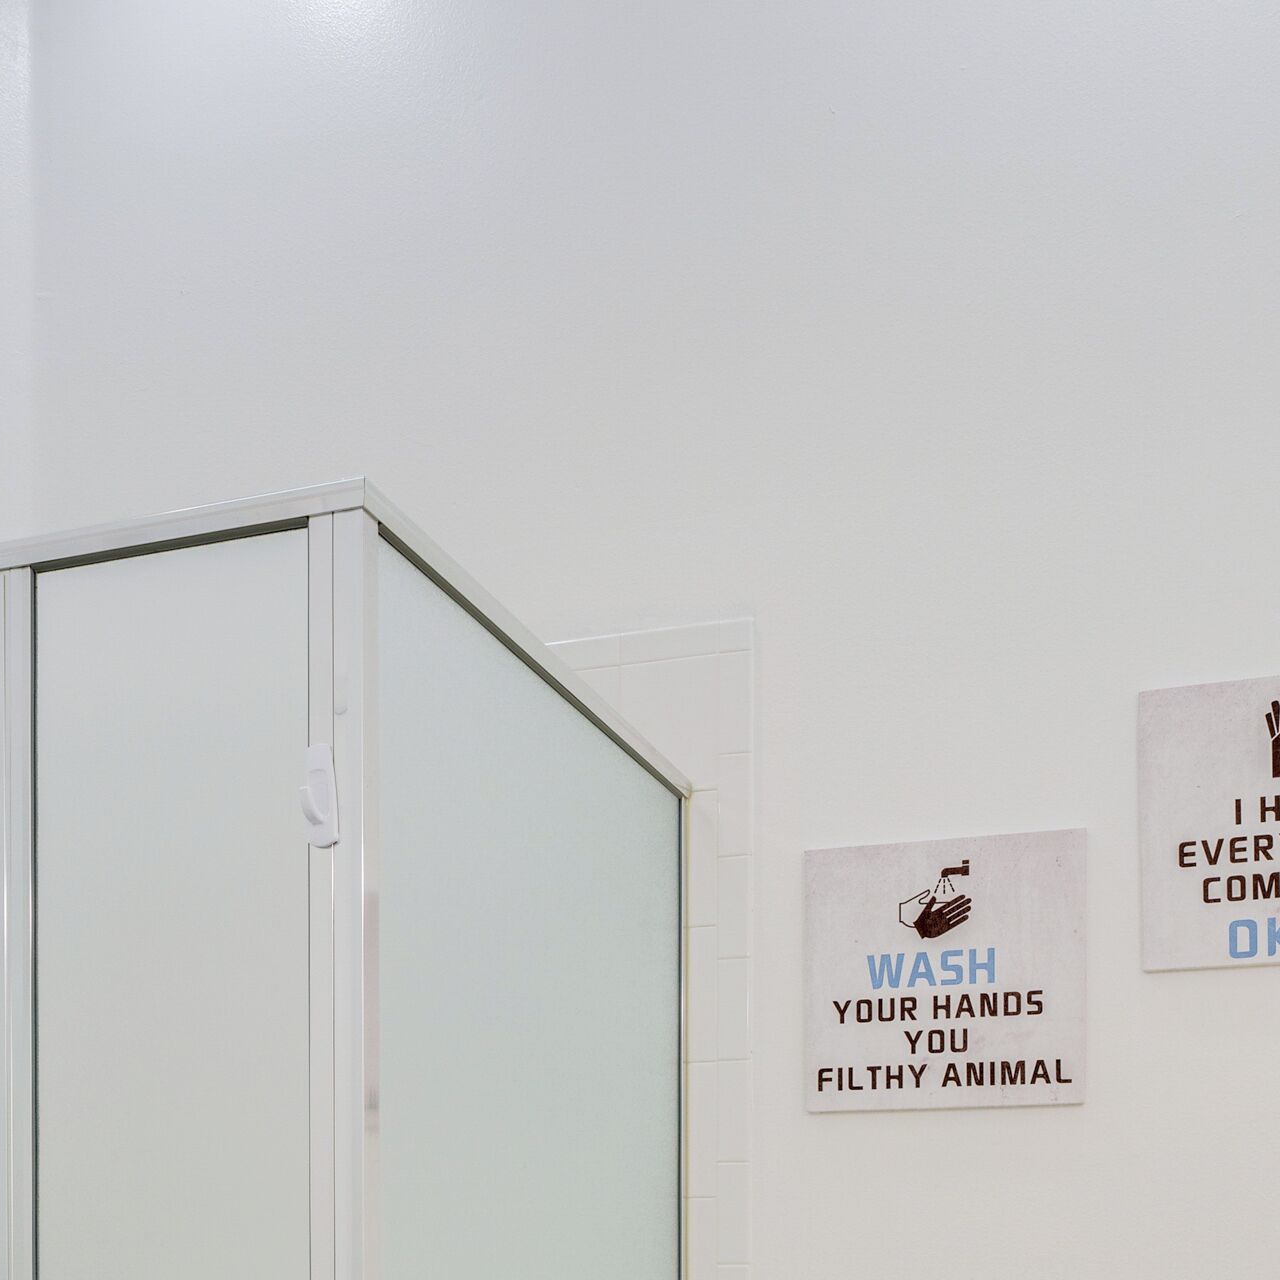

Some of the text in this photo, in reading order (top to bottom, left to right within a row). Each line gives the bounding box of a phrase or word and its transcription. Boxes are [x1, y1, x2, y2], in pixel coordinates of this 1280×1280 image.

[1234, 798, 1246, 826] I
[867, 948, 997, 989] WASH
[832, 989, 1045, 1025] YOUR HANDS
[903, 1028, 969, 1055] YOU
[816, 1058, 1073, 1092] FILTHY ANIMAL
